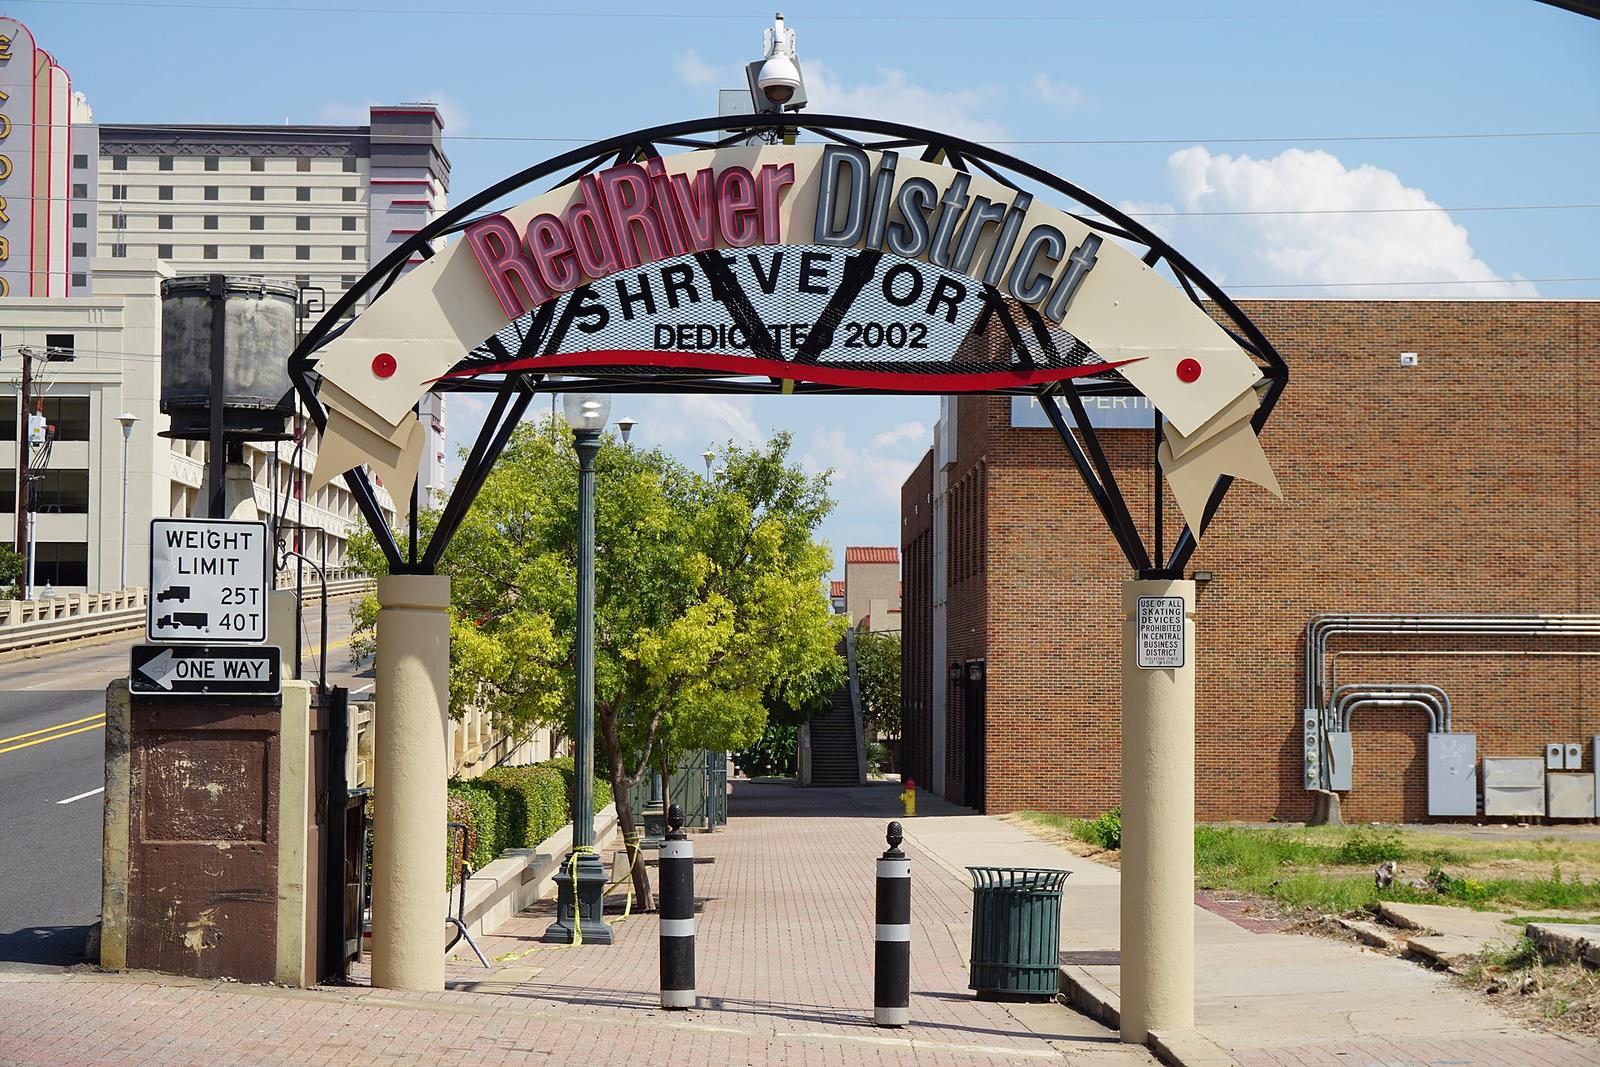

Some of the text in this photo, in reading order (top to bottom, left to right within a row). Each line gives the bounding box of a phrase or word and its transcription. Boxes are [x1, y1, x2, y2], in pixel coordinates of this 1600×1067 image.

[814, 144, 1104, 324] District
[573, 251, 1012, 334] SHRVEORT
[654, 321, 927, 350] DEDICTE 2002
[166, 530, 253, 550] WEIGHT
[178, 556, 240, 576] LIMIT
[220, 587, 260, 605] 25T
[218, 613, 260, 631] 40T
[1141, 624, 1181, 632] PROHIBITED
[1142, 616, 1181, 624] DEVICES
[176, 660, 264, 679] ONE WAY
